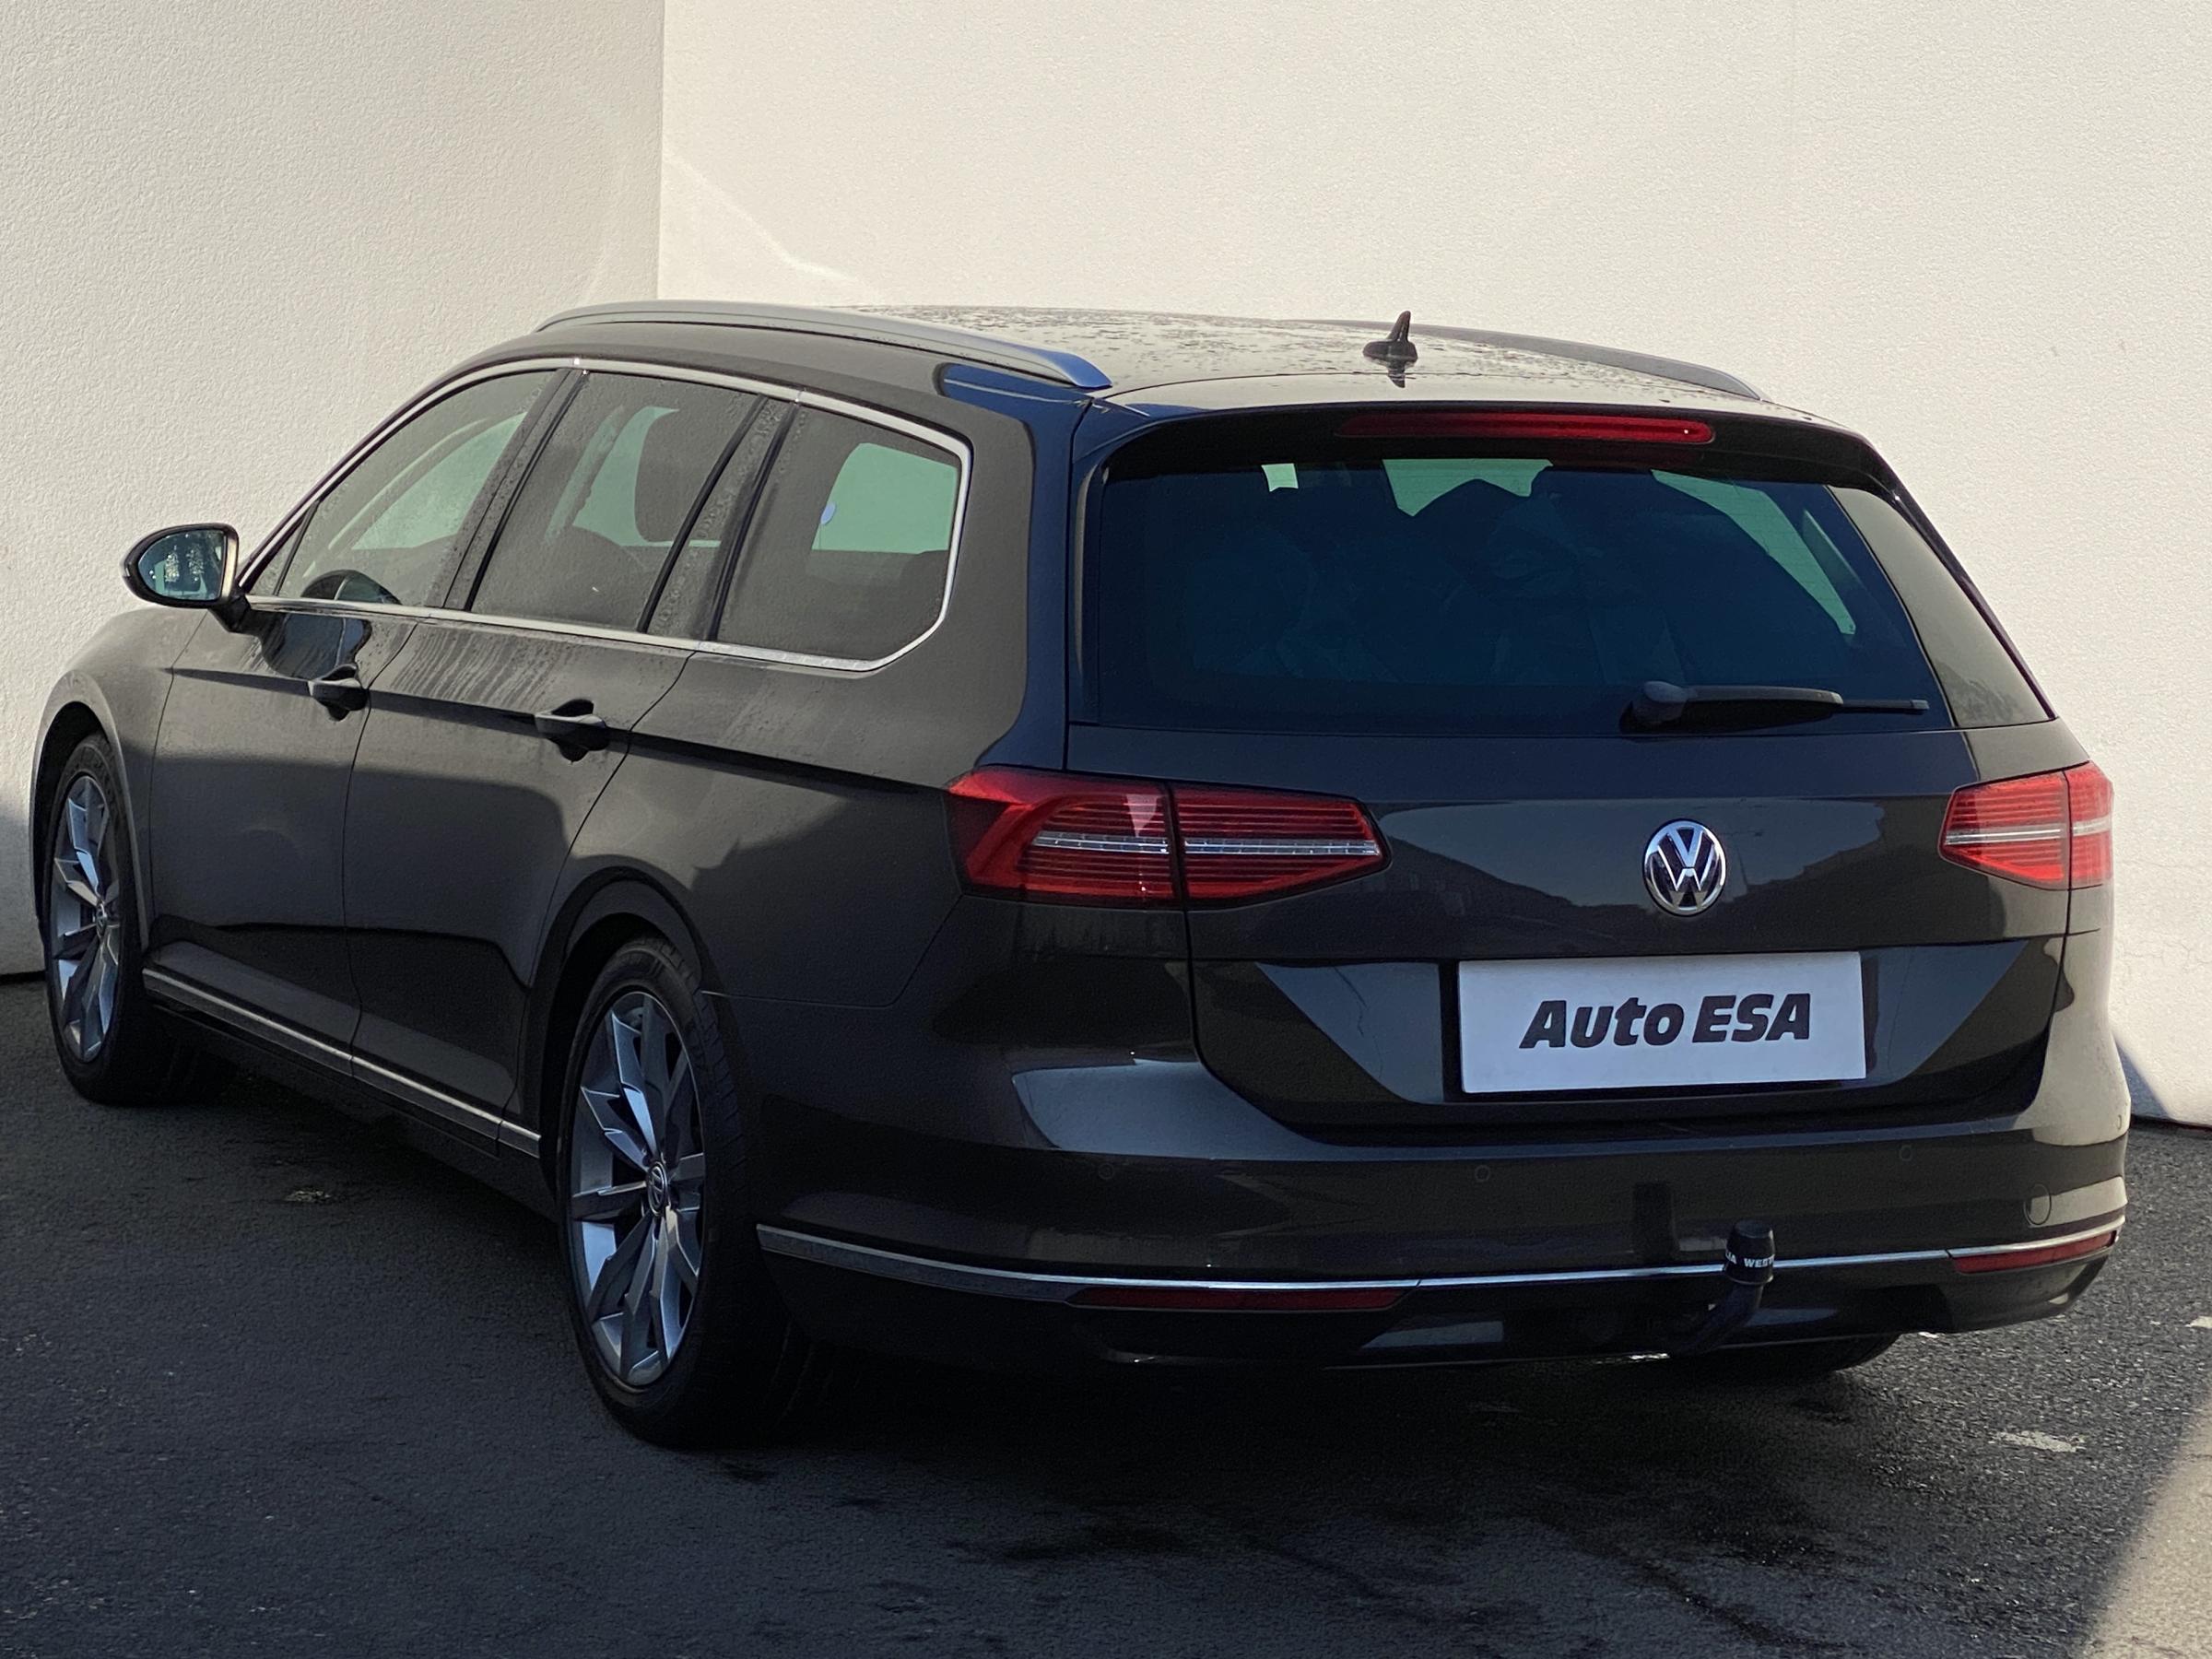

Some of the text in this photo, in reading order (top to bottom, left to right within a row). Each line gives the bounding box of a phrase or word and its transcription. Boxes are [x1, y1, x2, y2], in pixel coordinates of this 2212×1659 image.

[1645, 820, 1726, 914] VW
[1518, 993, 1811, 1049] Auto ESA
